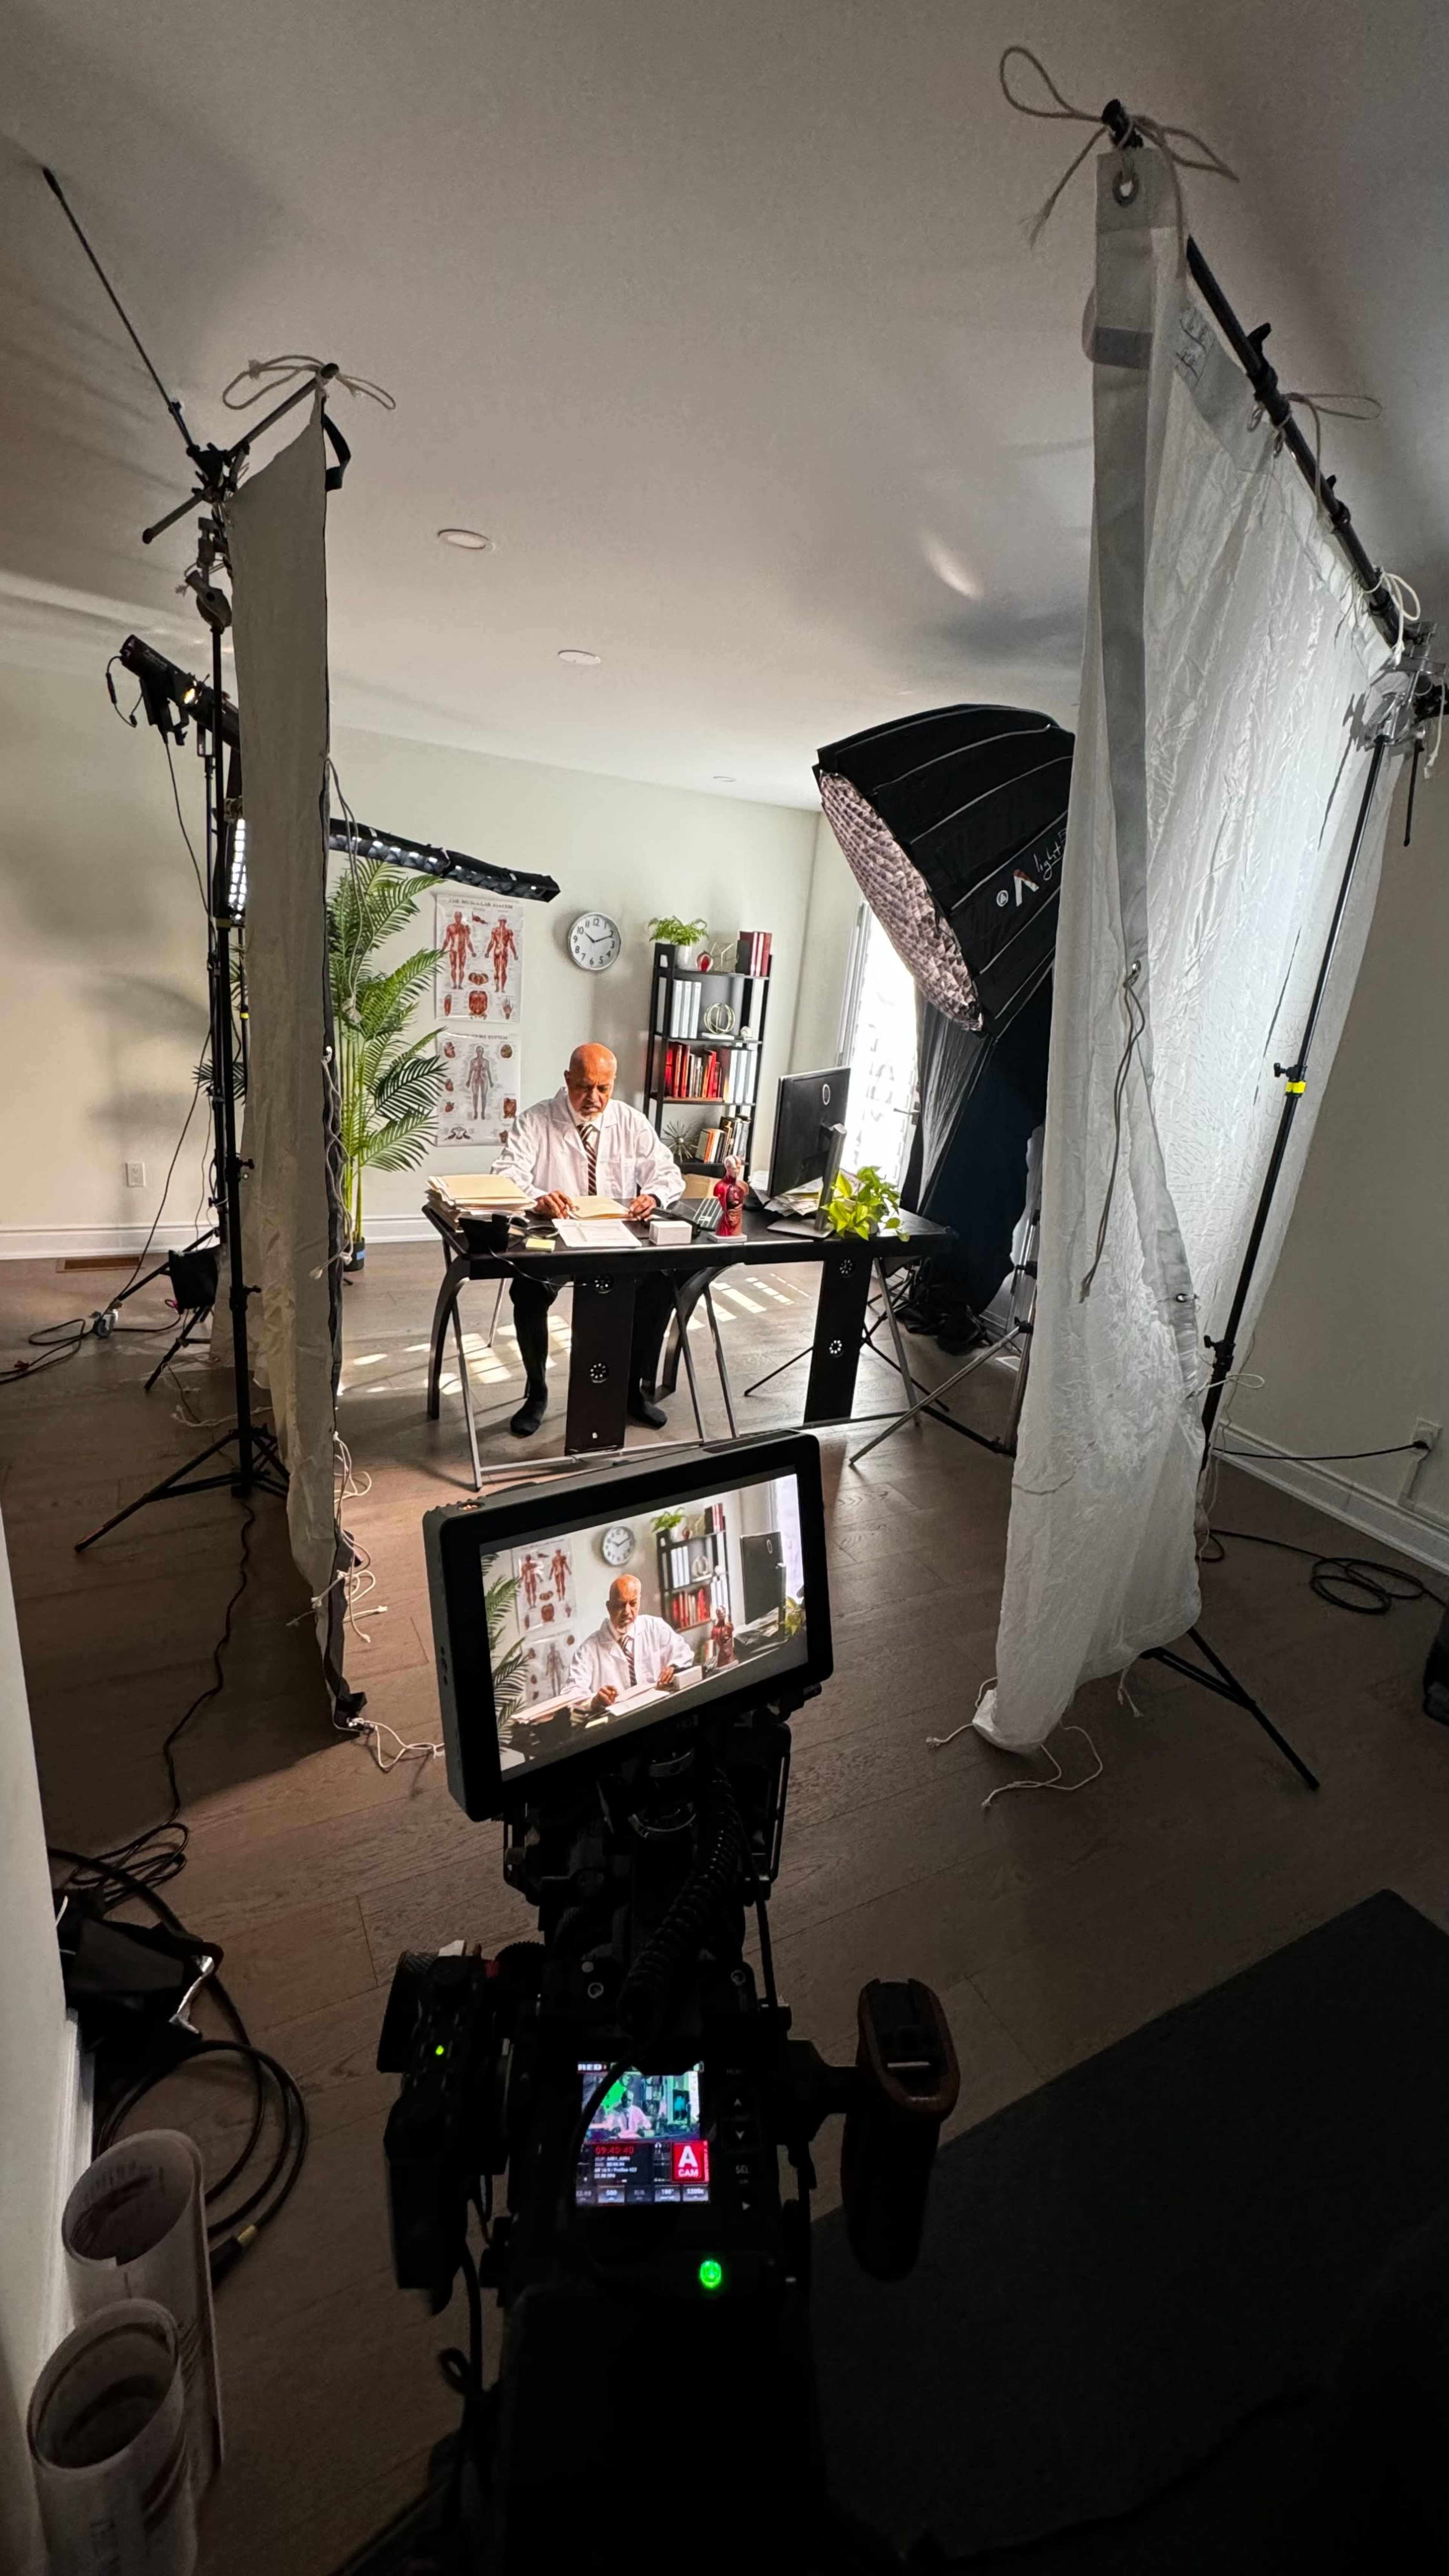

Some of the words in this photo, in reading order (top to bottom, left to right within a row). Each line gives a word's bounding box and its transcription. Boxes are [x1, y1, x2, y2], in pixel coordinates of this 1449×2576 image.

[1033, 841, 1061, 881] light
[593, 918, 600, 927] 12
[605, 921, 608, 929] 1
[609, 930, 614, 938] 2
[610, 940, 615, 949] 3
[575, 945, 580, 954] 8
[581, 953, 586, 961] 7
[599, 955, 603, 964] 5
[678, 2145, 698, 2168] A
[678, 2168, 699, 2178] CAM
